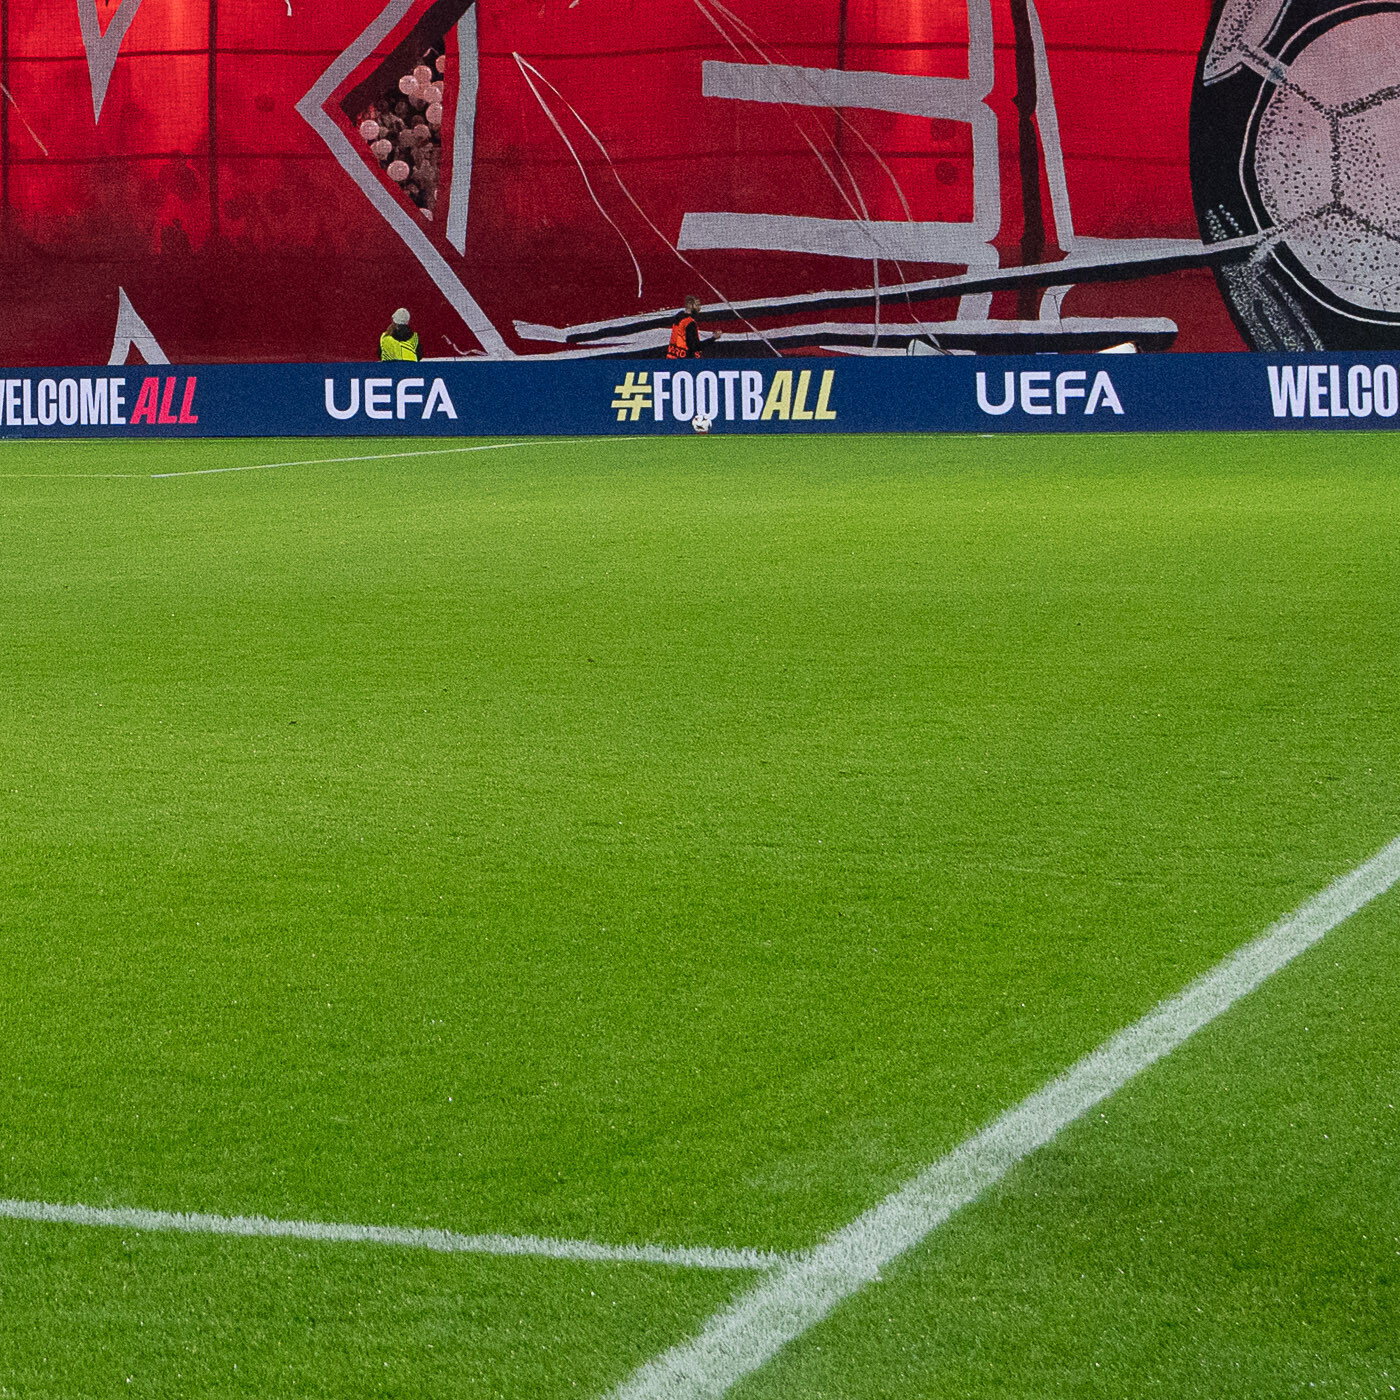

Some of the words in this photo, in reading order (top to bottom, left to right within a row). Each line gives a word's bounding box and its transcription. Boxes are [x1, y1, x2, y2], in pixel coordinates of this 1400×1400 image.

[130, 376, 199, 425] ALL
[324, 378, 458, 420] UEFA
[610, 369, 837, 422] #FOOTBALL
[976, 371, 1125, 415] UEFA
